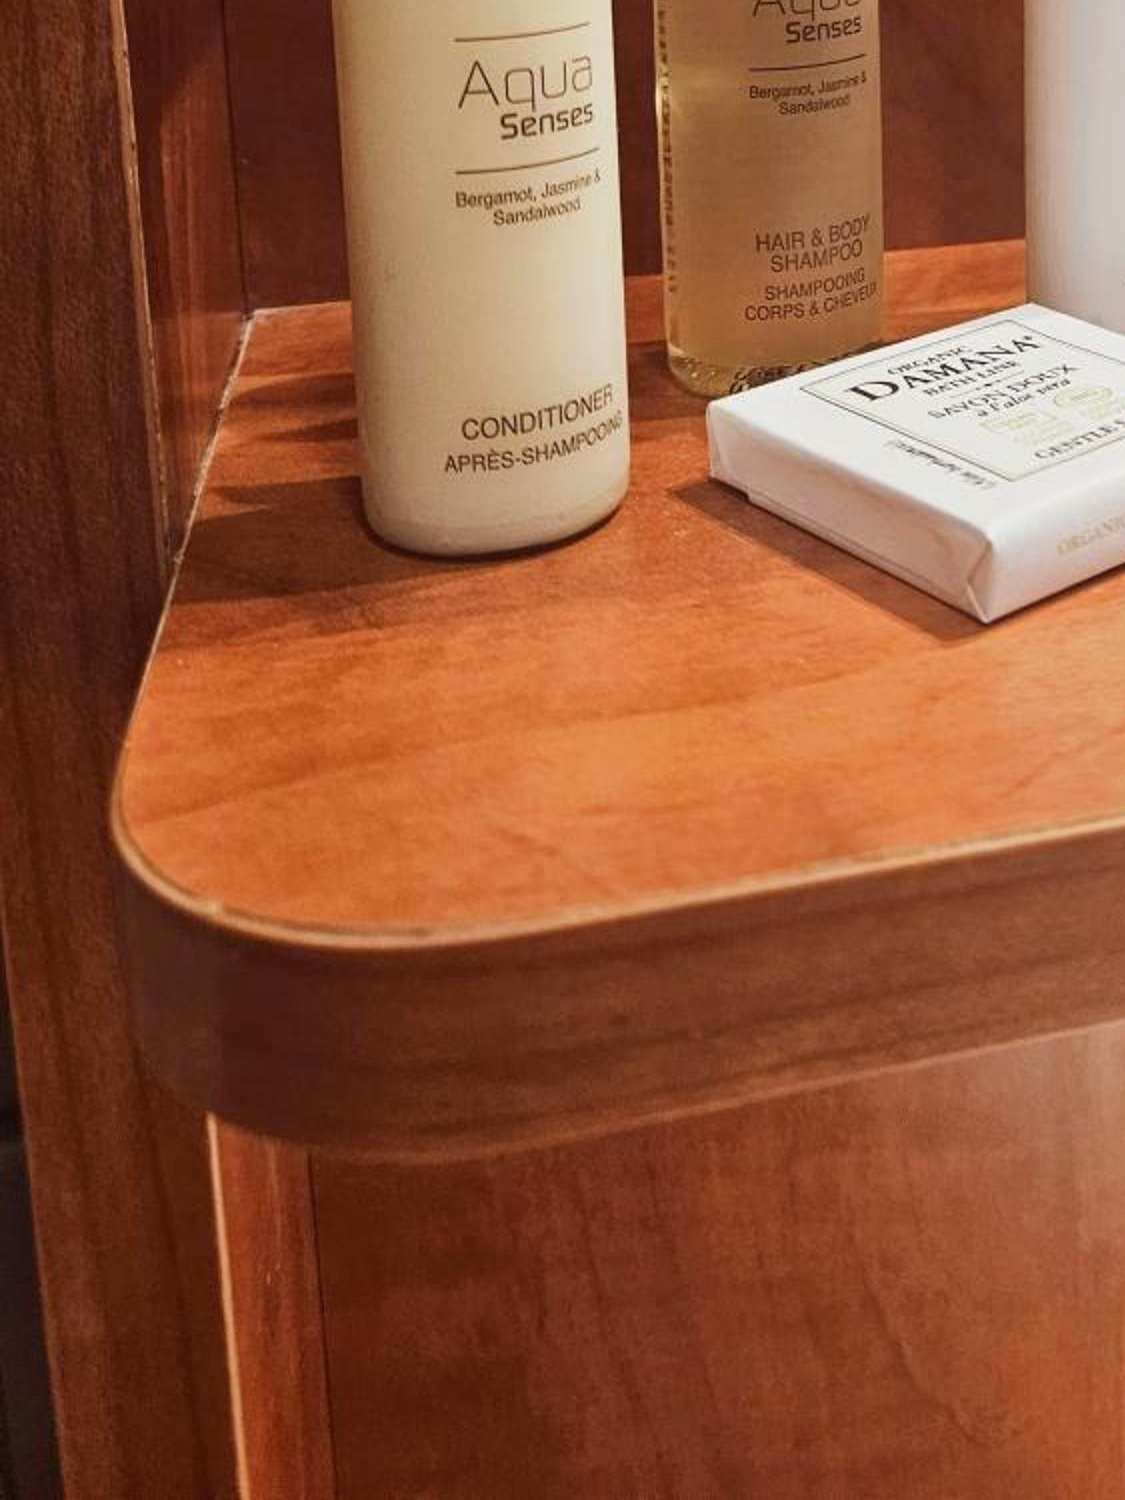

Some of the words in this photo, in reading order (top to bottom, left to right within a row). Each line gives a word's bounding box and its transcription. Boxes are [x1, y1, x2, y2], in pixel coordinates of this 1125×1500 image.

[785, 17, 862, 44] Senses
[457, 55, 593, 112] Aqua
[500, 103, 593, 140] Senses
[779, 94, 850, 115] Sandalwood
[455, 187, 537, 210] Bergamot,
[541, 174, 591, 198] Jasmine
[493, 198, 581, 226] Sandalwood
[755, 231, 805, 252] HAIR
[811, 228, 822, 247] &
[829, 214, 869, 244] BODY
[771, 238, 862, 273] SHAMPOO
[765, 267, 865, 301] SHAMPOOING
[745, 303, 805, 321] CORPS
[810, 301, 819, 316] &
[923, 375, 975, 397] BATH
[979, 359, 1021, 380] LINE
[927, 386, 1006, 419] SAVON
[1006, 364, 1078, 395] DOUX
[461, 383, 613, 440] CONDITIONER
[445, 410, 624, 473] APRÈS-SHAMPOOING
[1034, 424, 1118, 459] GENTLE
